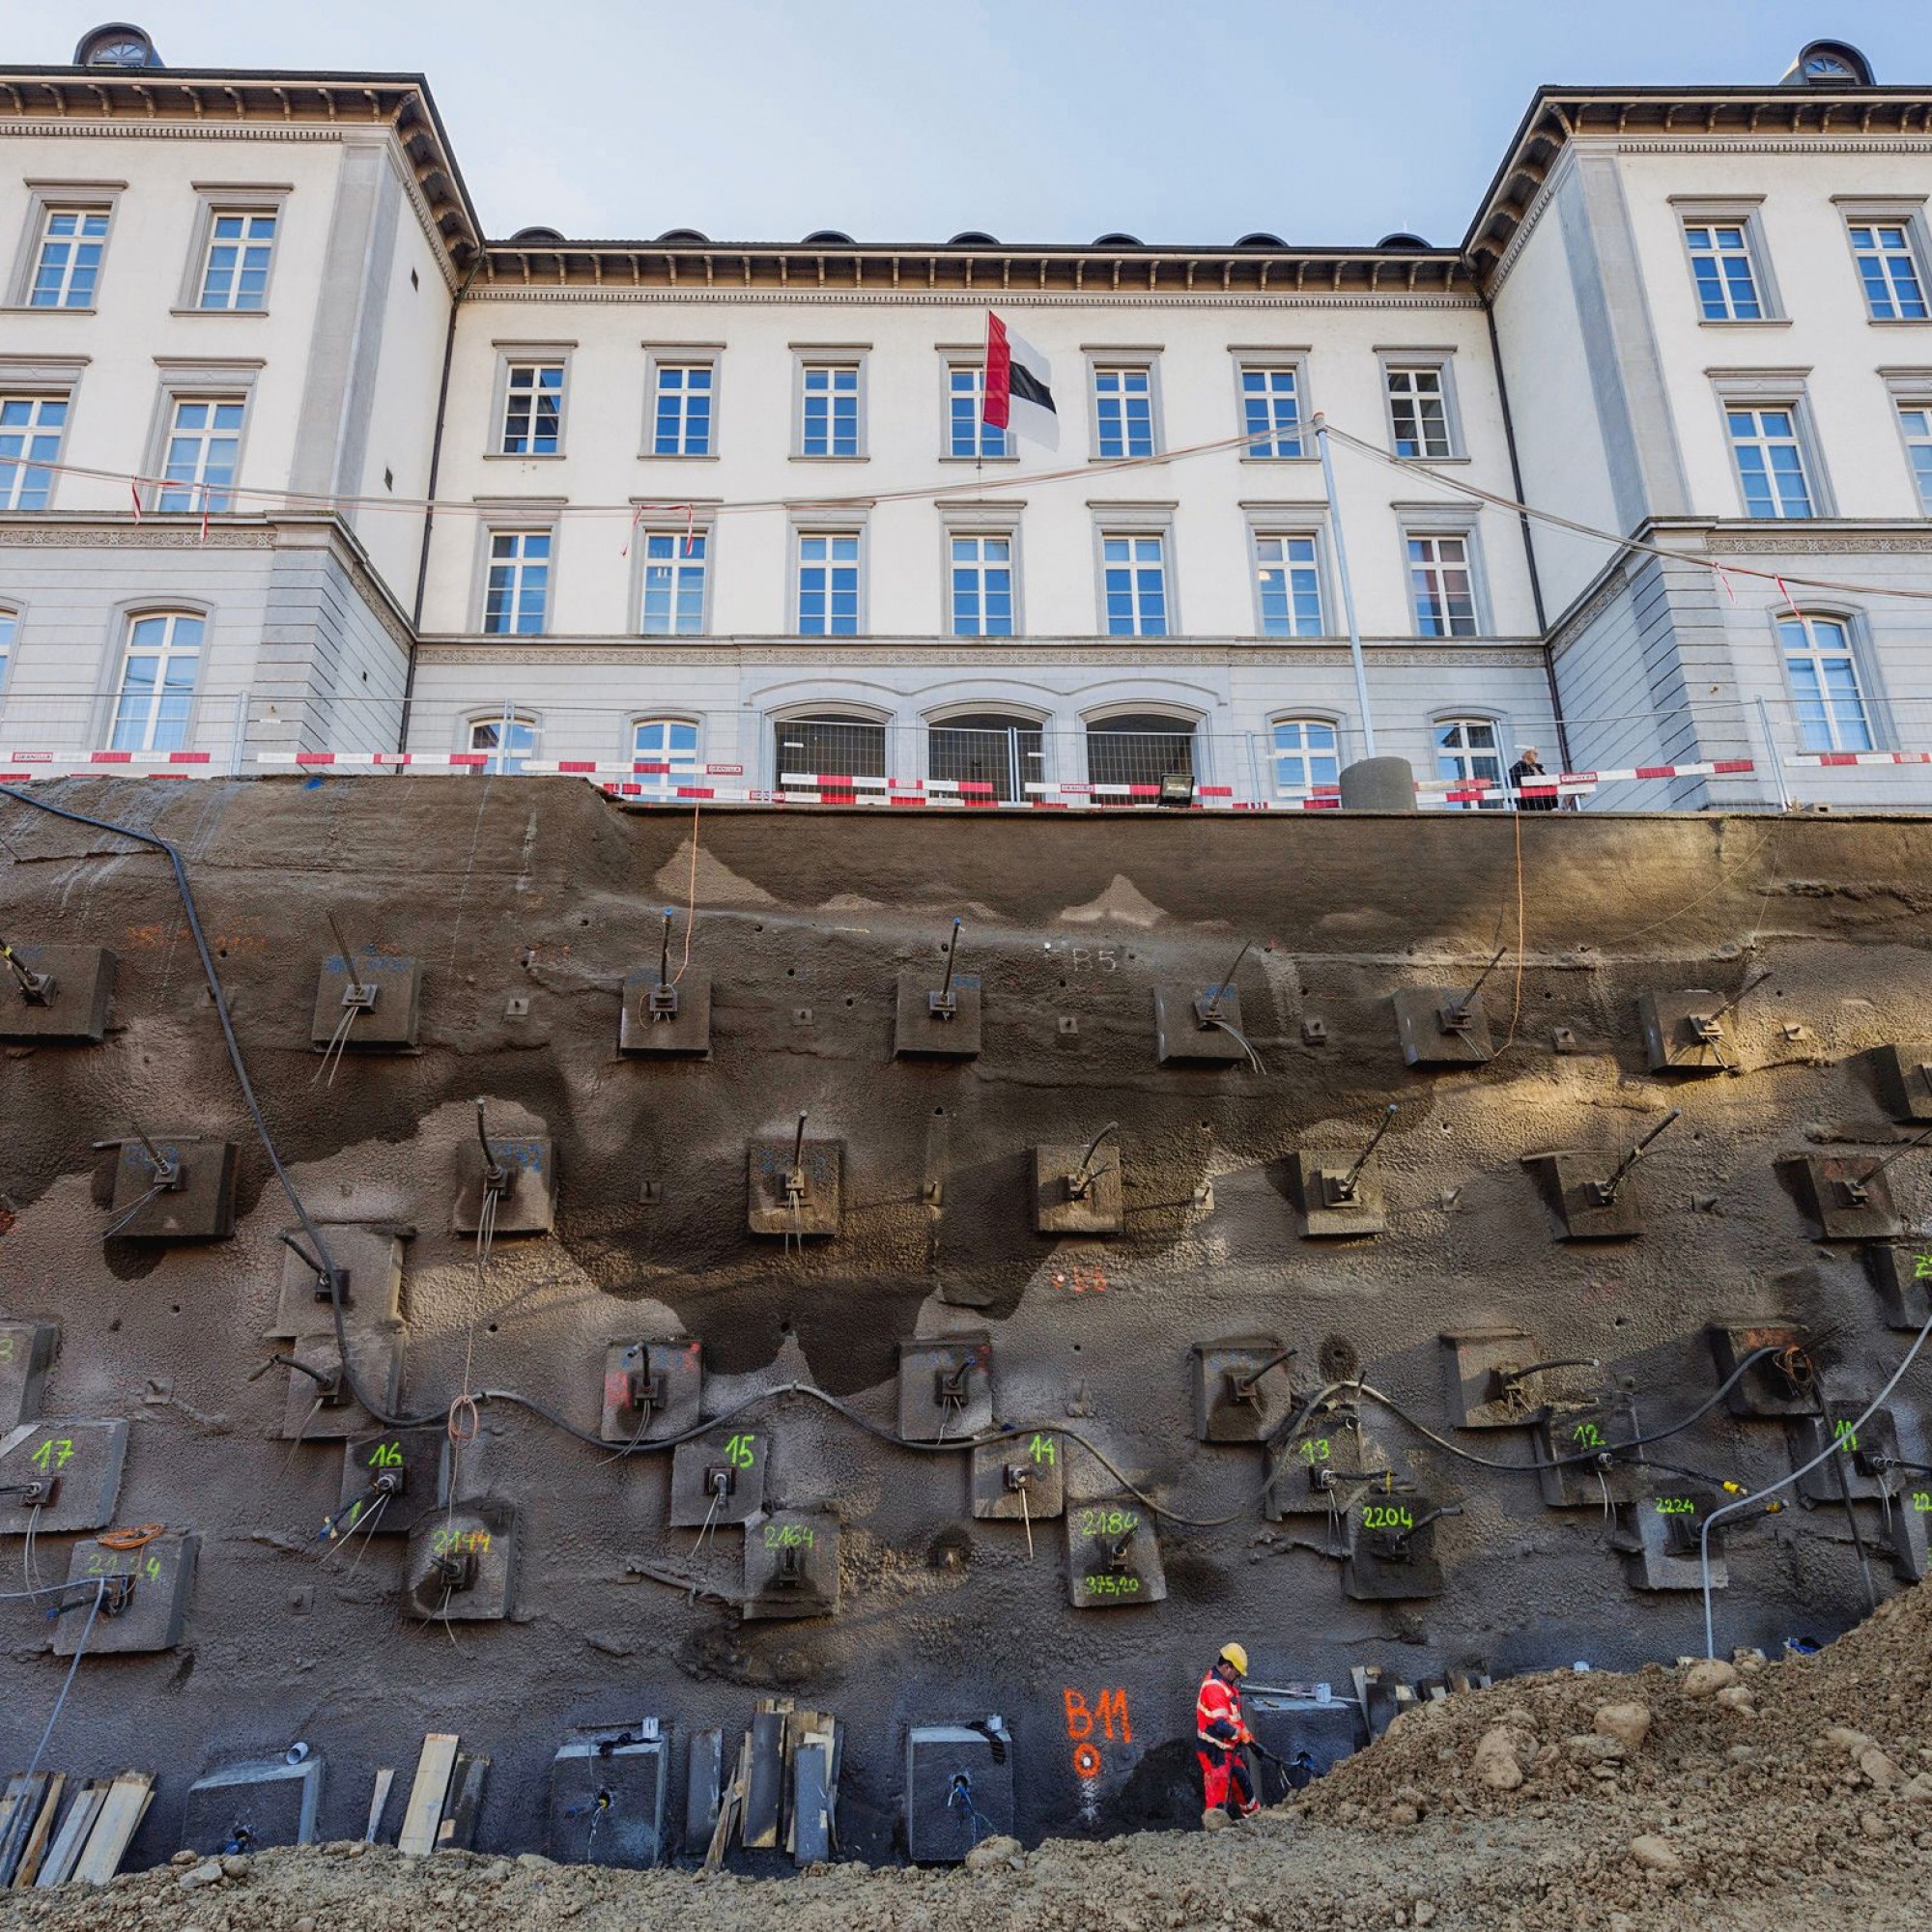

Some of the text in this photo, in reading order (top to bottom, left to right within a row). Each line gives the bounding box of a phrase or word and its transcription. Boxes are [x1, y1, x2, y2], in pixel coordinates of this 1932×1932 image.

[1074, 948, 1117, 972] B5
[1574, 1423, 1607, 1449] 12
[1835, 1419, 1858, 1452] 11
[32, 1438, 73, 1468] 17
[368, 1440, 403, 1467] 16
[724, 1435, 754, 1468] 15
[1029, 1435, 1055, 1465] 14
[1299, 1438, 1330, 1463] 13
[1362, 1506, 1413, 1529] 2204
[1655, 1497, 1694, 1515] 2224
[1081, 1509, 1140, 1536] 2184
[432, 1529, 492, 1553] 2144
[763, 1524, 813, 1548] 2164
[1064, 1688, 1132, 1745] B11
